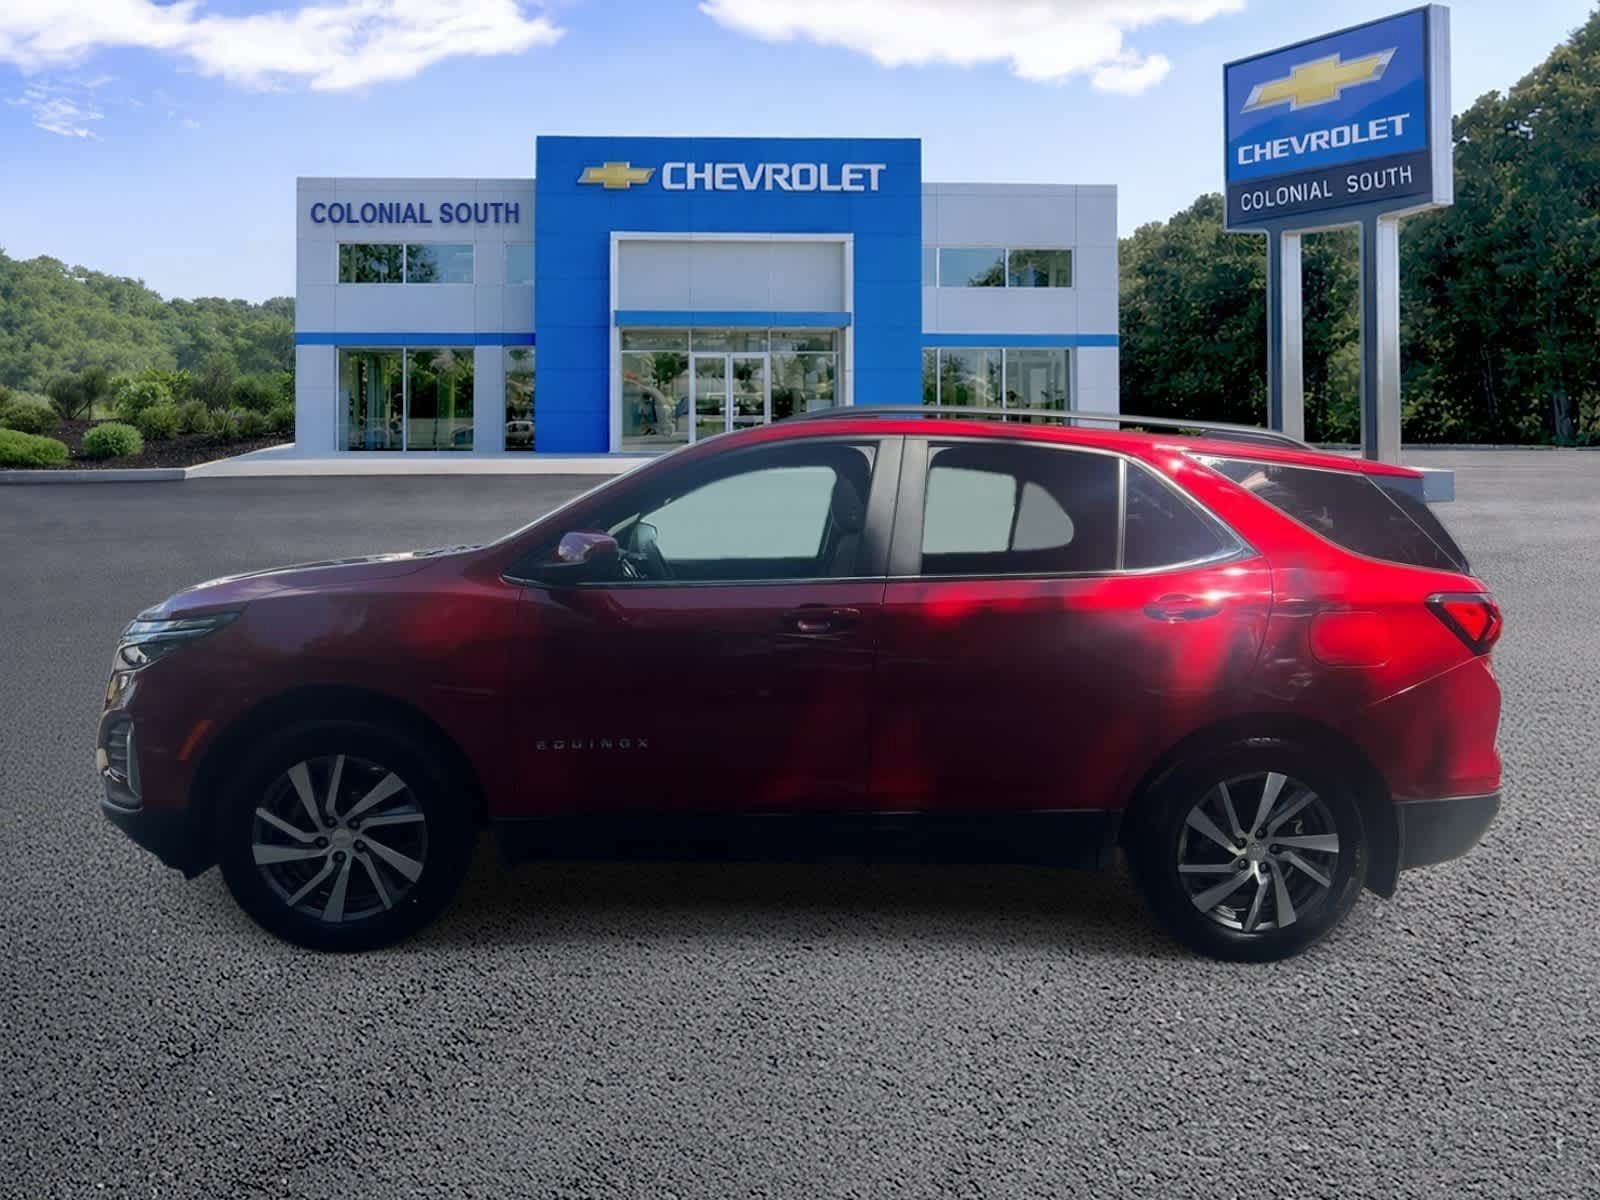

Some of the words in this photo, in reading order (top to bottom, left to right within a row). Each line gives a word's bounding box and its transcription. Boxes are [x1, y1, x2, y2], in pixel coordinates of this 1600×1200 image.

[1238, 113, 1410, 165] CHEVROLET
[662, 162, 887, 191] CHEVROLET
[1241, 180, 1333, 211] COLONIAL
[1347, 165, 1412, 193] SOUTH
[310, 202, 433, 224] COLONIAL
[440, 202, 520, 224] SOUTH
[536, 738, 649, 751] EQUINOX
